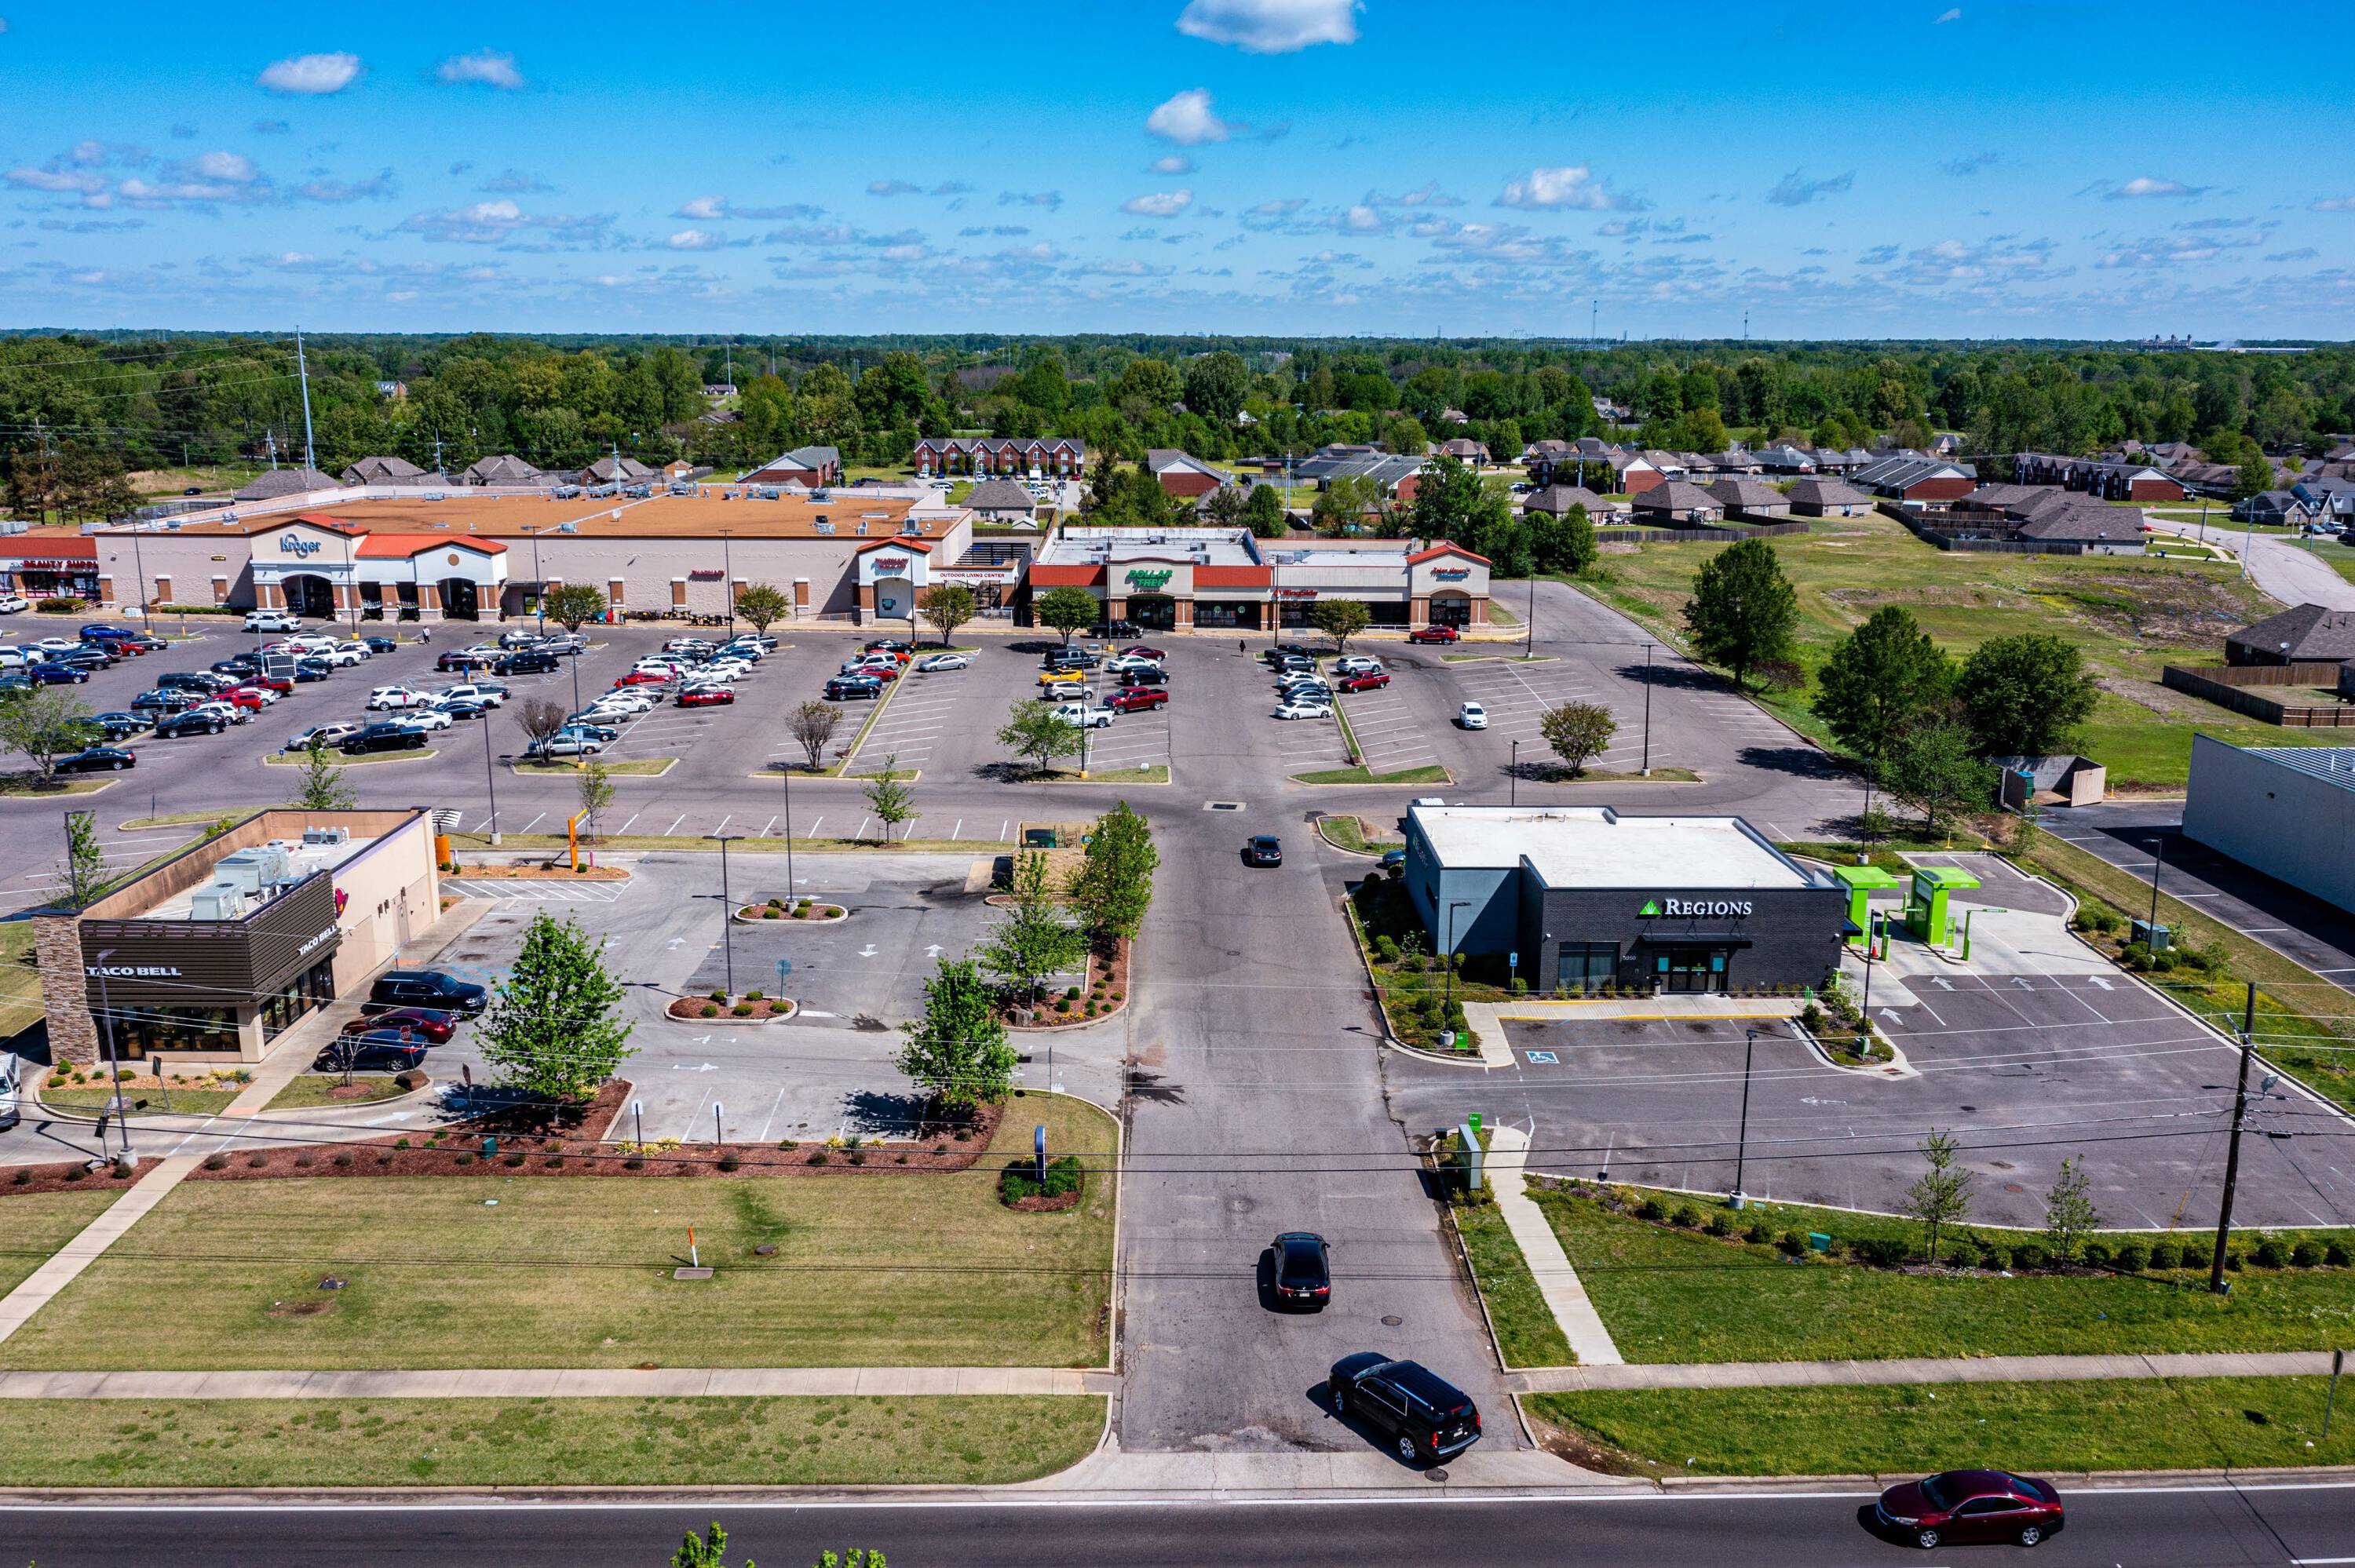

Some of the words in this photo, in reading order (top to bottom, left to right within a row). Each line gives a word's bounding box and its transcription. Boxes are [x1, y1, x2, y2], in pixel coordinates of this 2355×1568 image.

[279, 533, 321, 559] Kroger
[1129, 569, 1173, 578] DOLLAR
[1137, 578, 1165, 587] TREE
[297, 936, 319, 956] TACO
[319, 924, 338, 942] BELL
[86, 966, 134, 976] TACO
[137, 966, 182, 976] BELL
